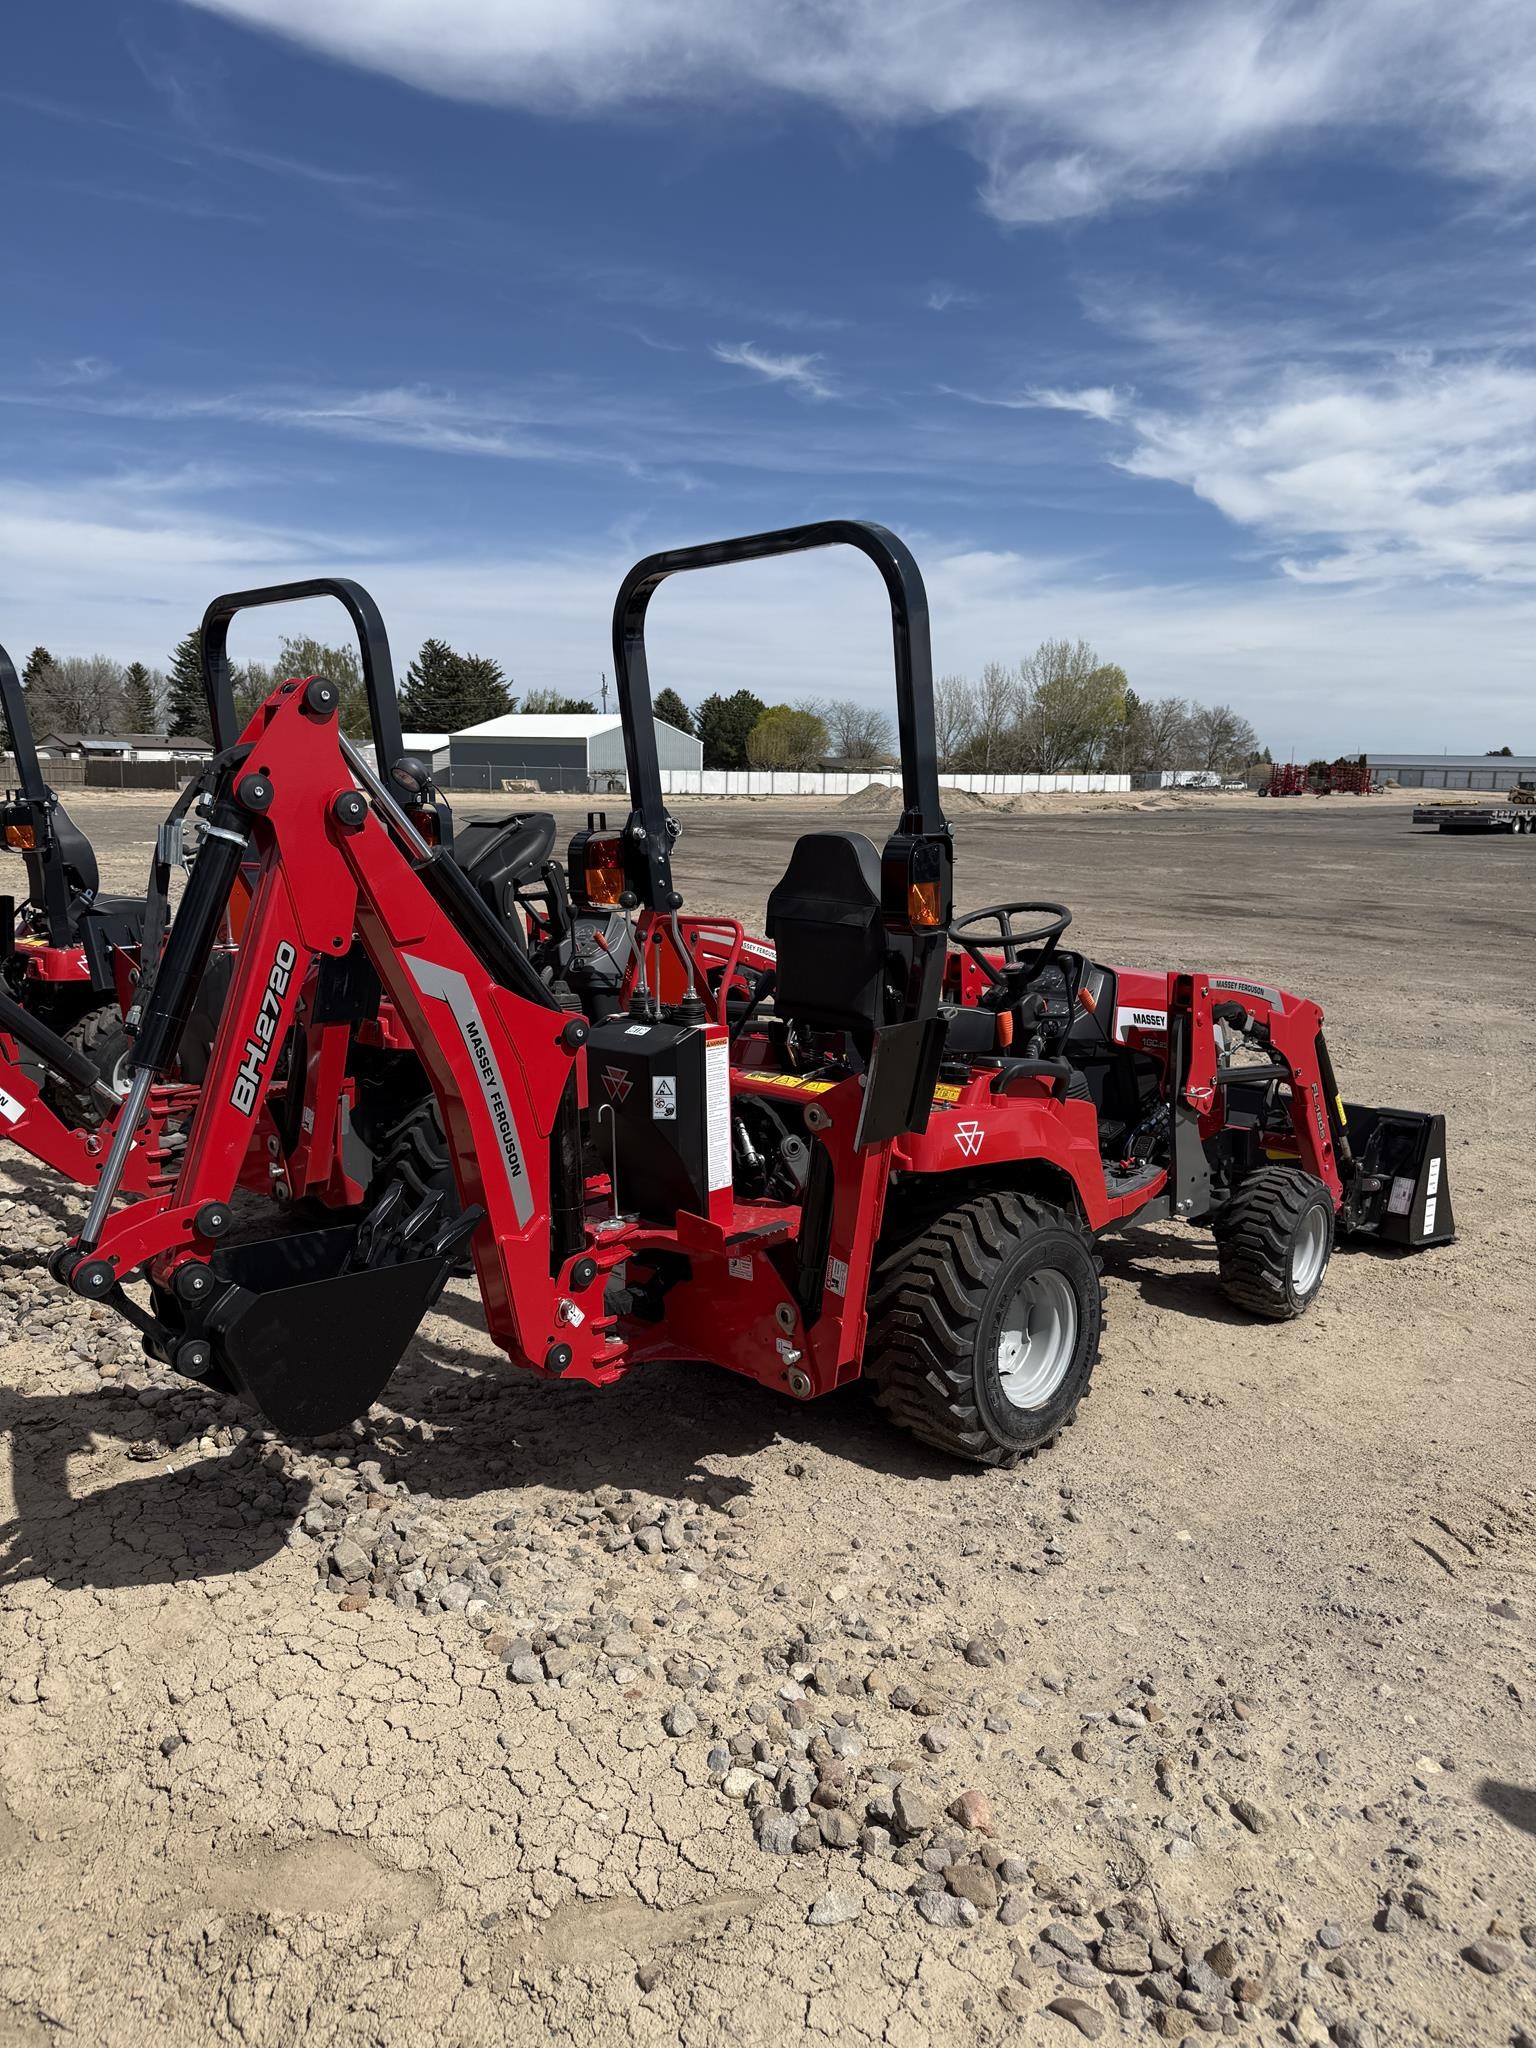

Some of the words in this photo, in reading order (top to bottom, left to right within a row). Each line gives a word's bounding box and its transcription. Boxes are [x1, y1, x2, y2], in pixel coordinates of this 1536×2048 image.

[756, 946, 777, 959] FERGUS
[1216, 980, 1238, 990] MASSEY
[1238, 983, 1265, 996] FERGUSON
[1133, 1013, 1165, 1026] MASSEY
[230, 940, 296, 1117] BH.2720
[466, 1020, 498, 1087] MASSEY
[490, 1091, 522, 1178] FERGUSON
